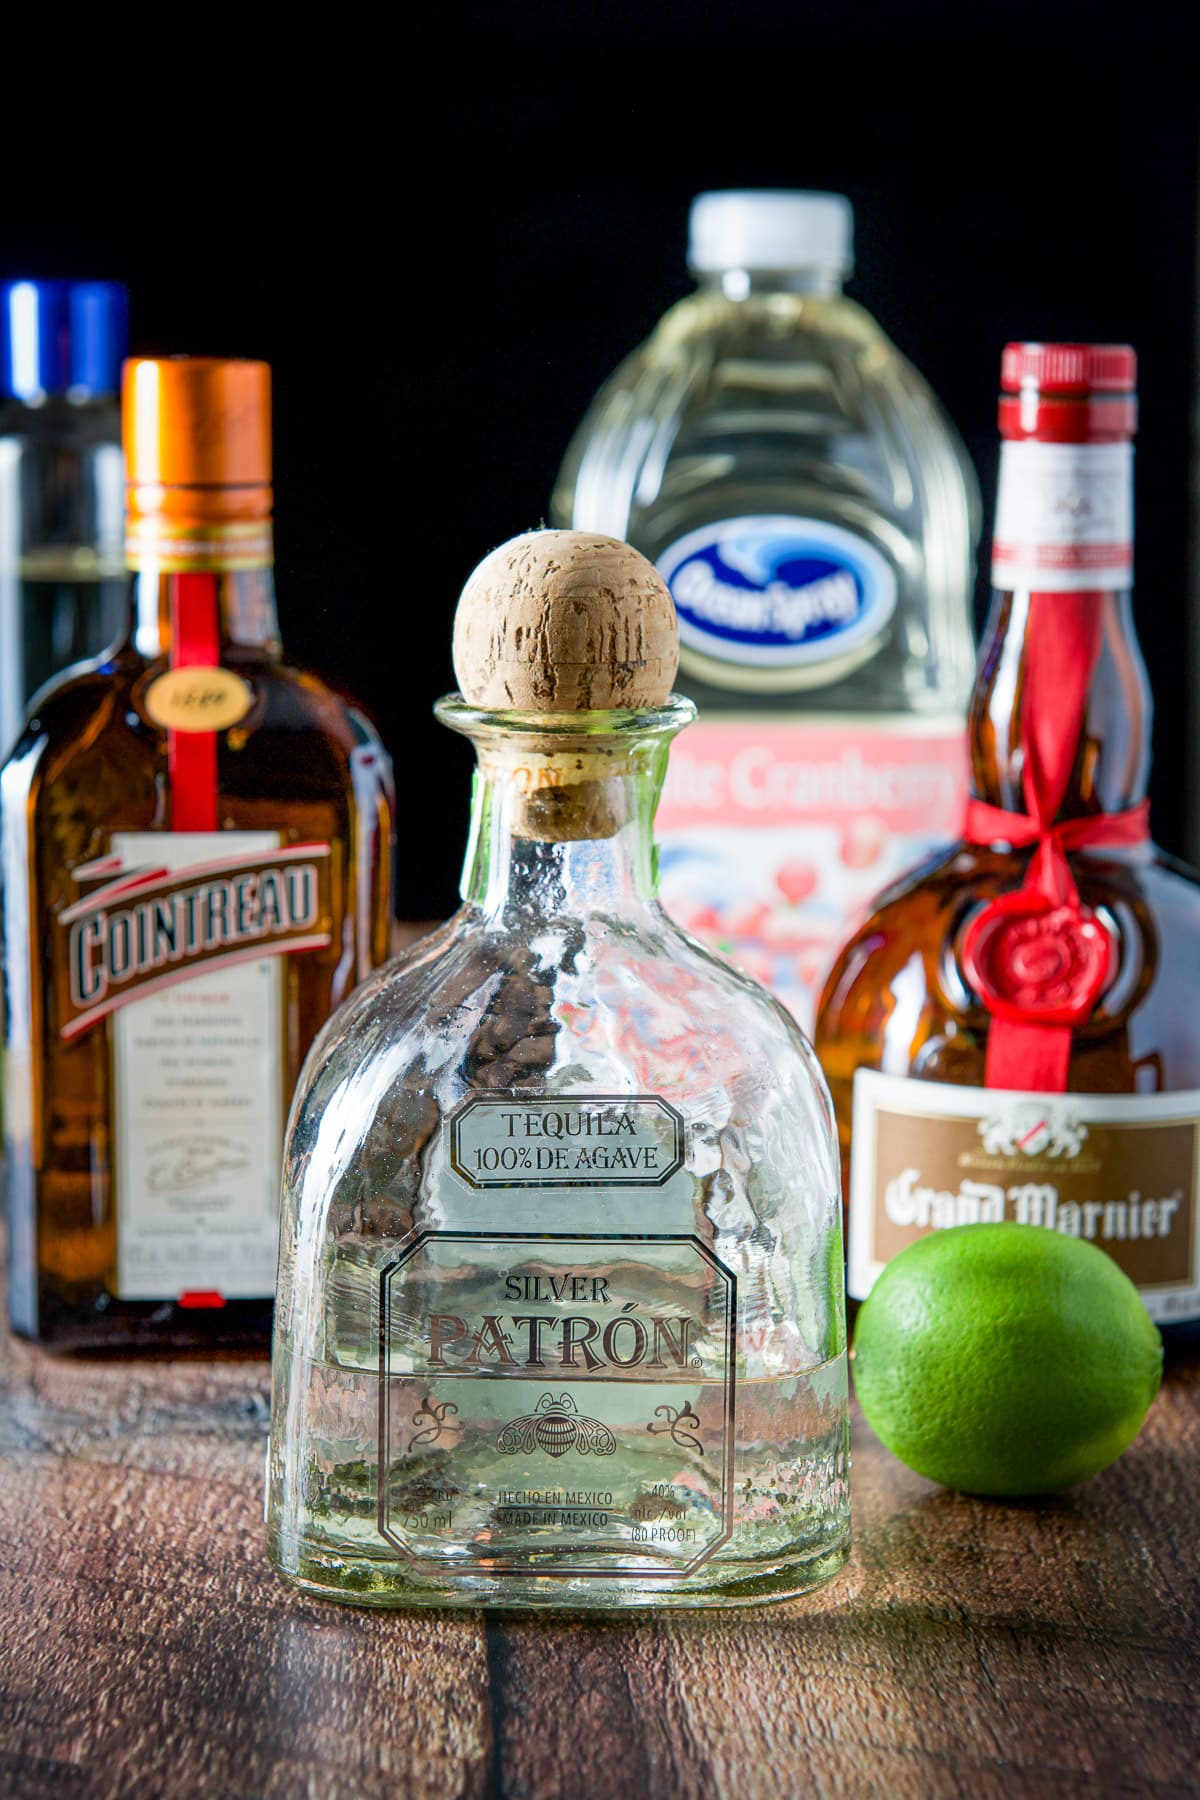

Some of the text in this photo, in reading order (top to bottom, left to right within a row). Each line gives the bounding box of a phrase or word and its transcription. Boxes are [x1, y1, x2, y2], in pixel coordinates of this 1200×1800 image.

[69, 864, 318, 1008] COINTREAU
[500, 1112, 638, 1140] TEQUILA
[474, 1146, 658, 1170] 100% DE AGAVE
[885, 1168, 1179, 1240] Grand Marnier
[504, 1272, 612, 1303] SILVER
[498, 1491, 613, 1505] HECHO EN MEXICO
[651, 1484, 675, 1498] 40%
[503, 1512, 608, 1526] MADE IN MEXICO
[631, 1527, 696, 1543] (80 PROOF)
